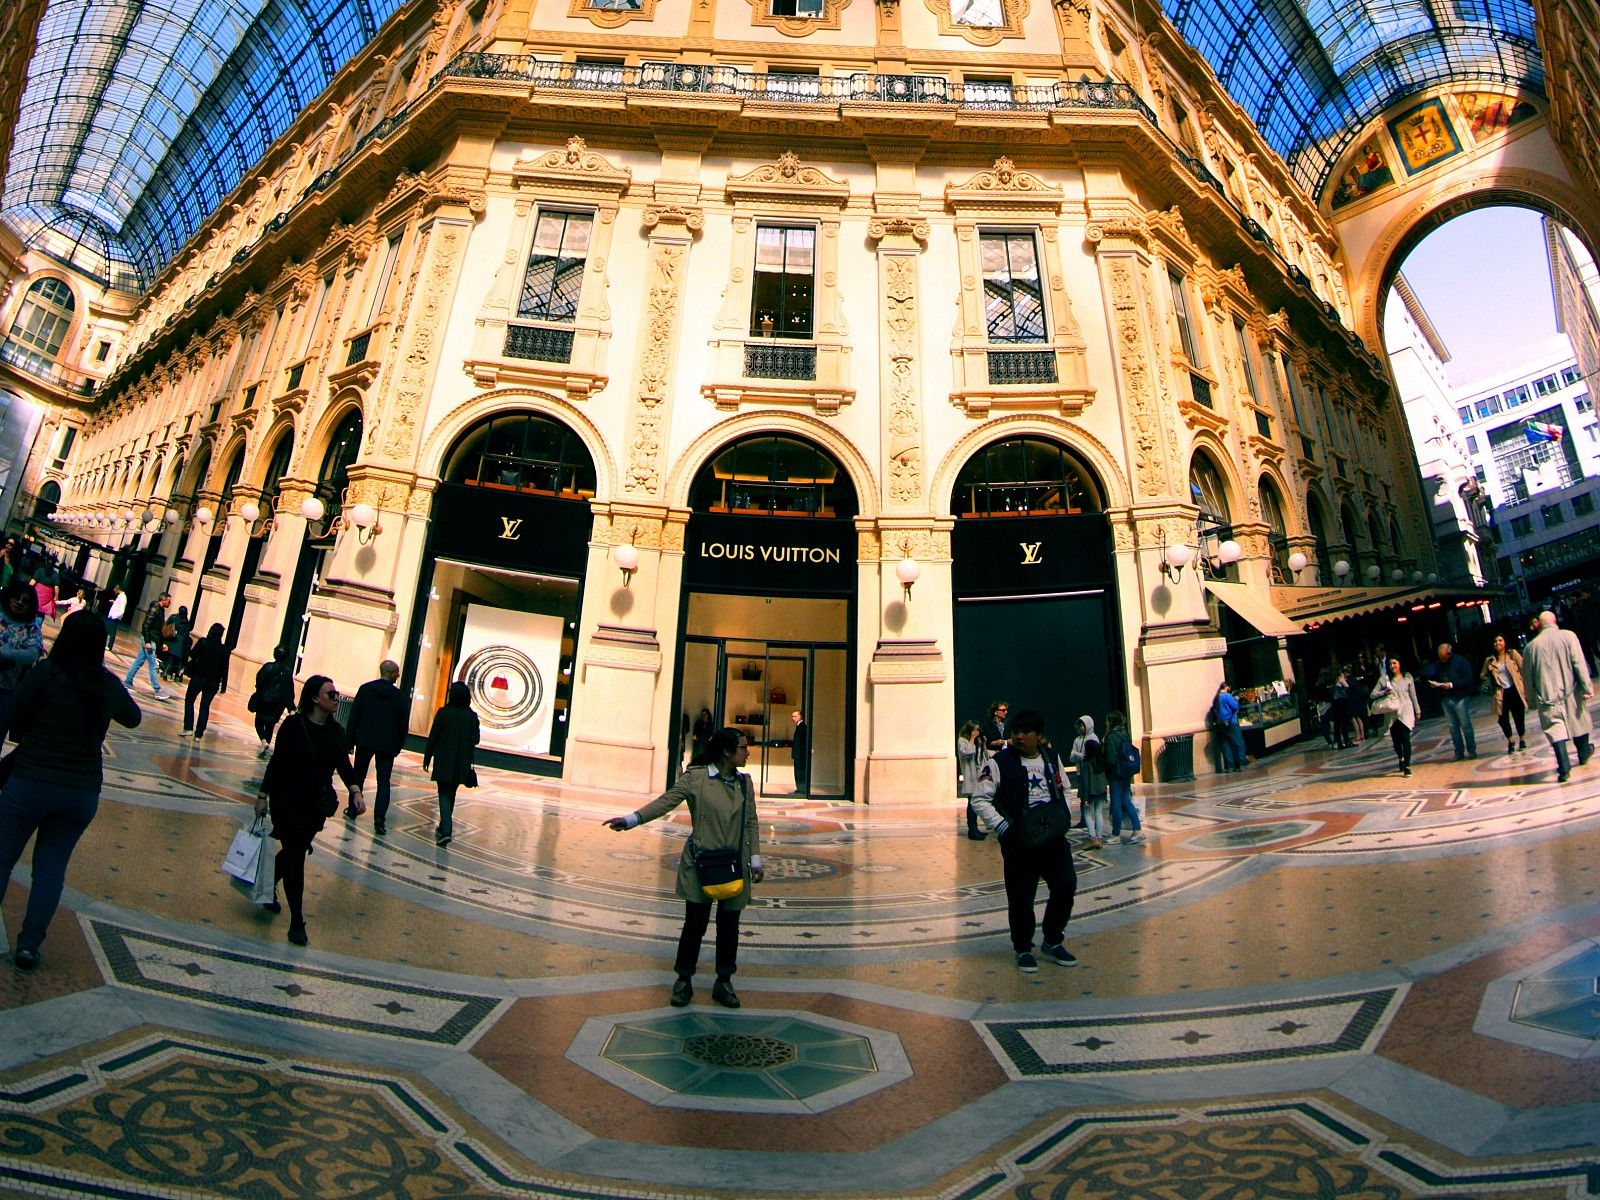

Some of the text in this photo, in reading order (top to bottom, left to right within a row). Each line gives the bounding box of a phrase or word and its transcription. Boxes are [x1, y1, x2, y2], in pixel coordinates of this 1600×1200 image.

[498, 517, 523, 540] LV
[701, 542, 840, 564] LOUIS VUITTON
[1020, 542, 1043, 564] LV
